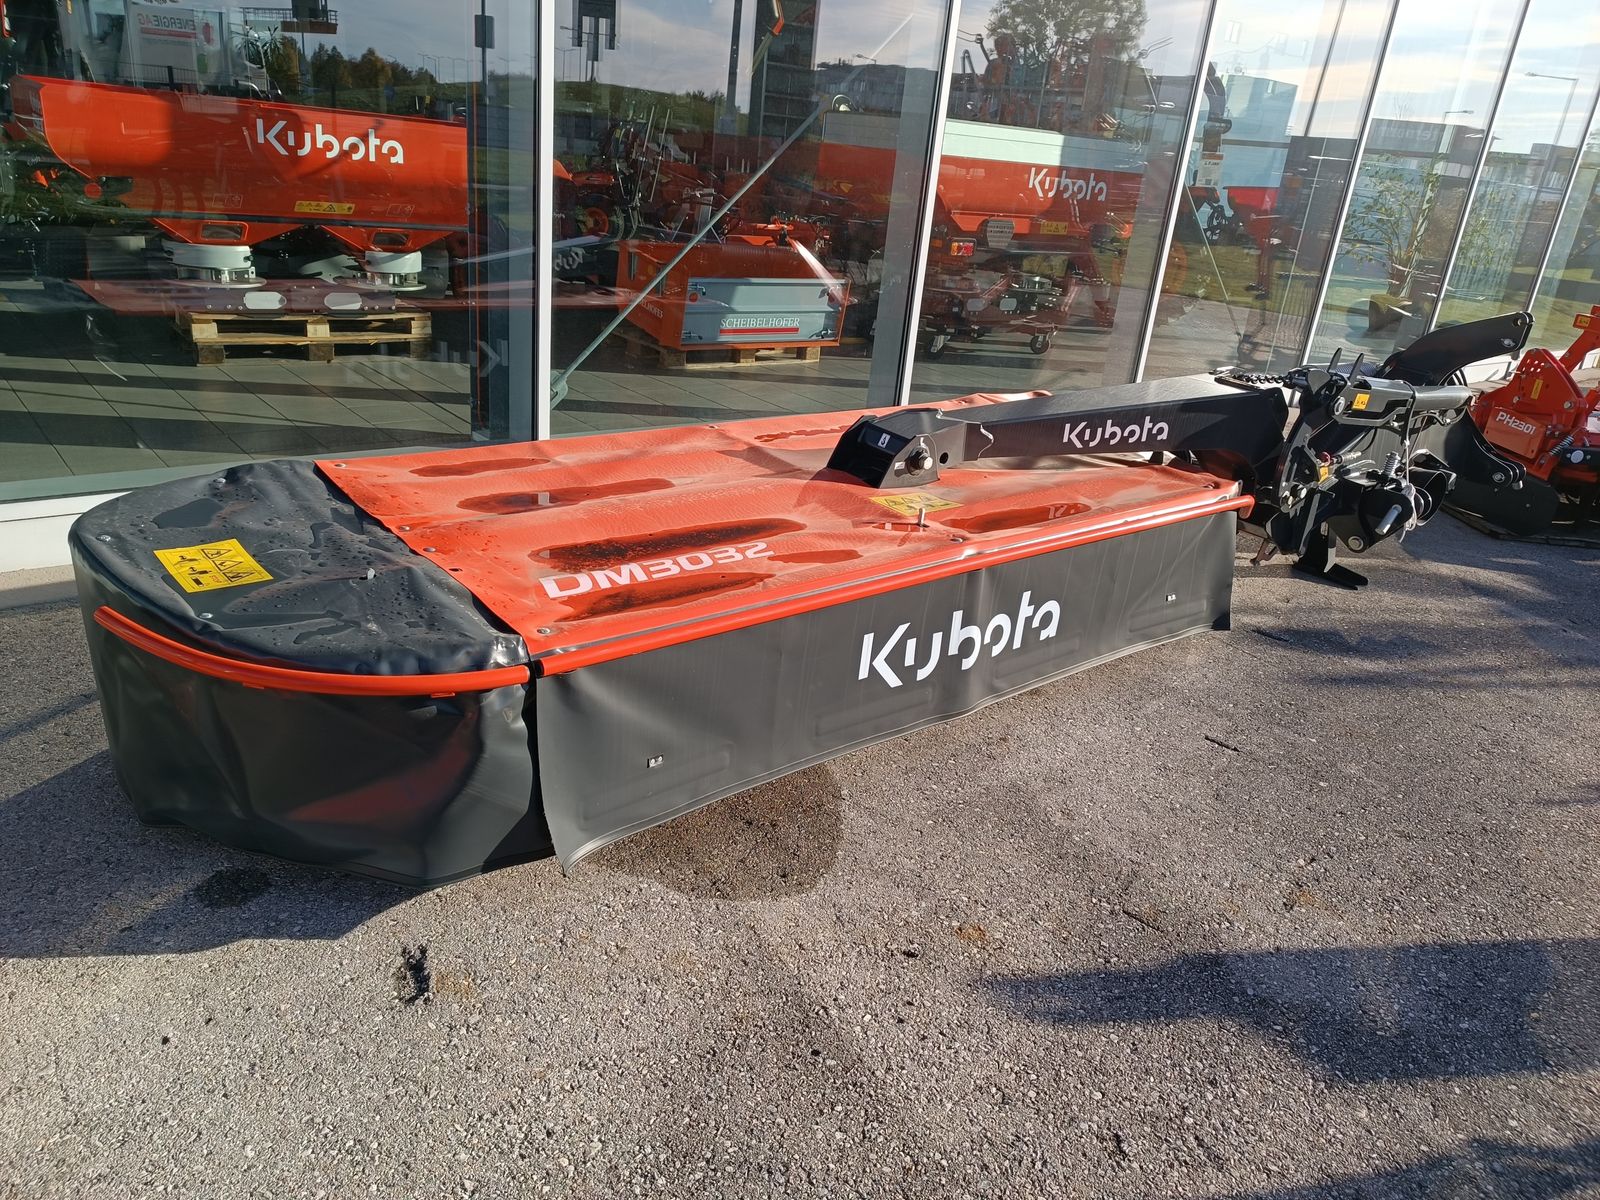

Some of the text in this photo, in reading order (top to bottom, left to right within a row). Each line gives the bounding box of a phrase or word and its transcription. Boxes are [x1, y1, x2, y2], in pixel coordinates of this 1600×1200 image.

[256, 118, 404, 164] Kubota
[1028, 167, 1107, 201] Kubota
[720, 317, 800, 328] SCHEIBELHOFER
[1062, 415, 1169, 448] Kubota
[1495, 411, 1536, 435] PH2301
[538, 541, 776, 599] DM3032
[858, 590, 1061, 688] Kubota
